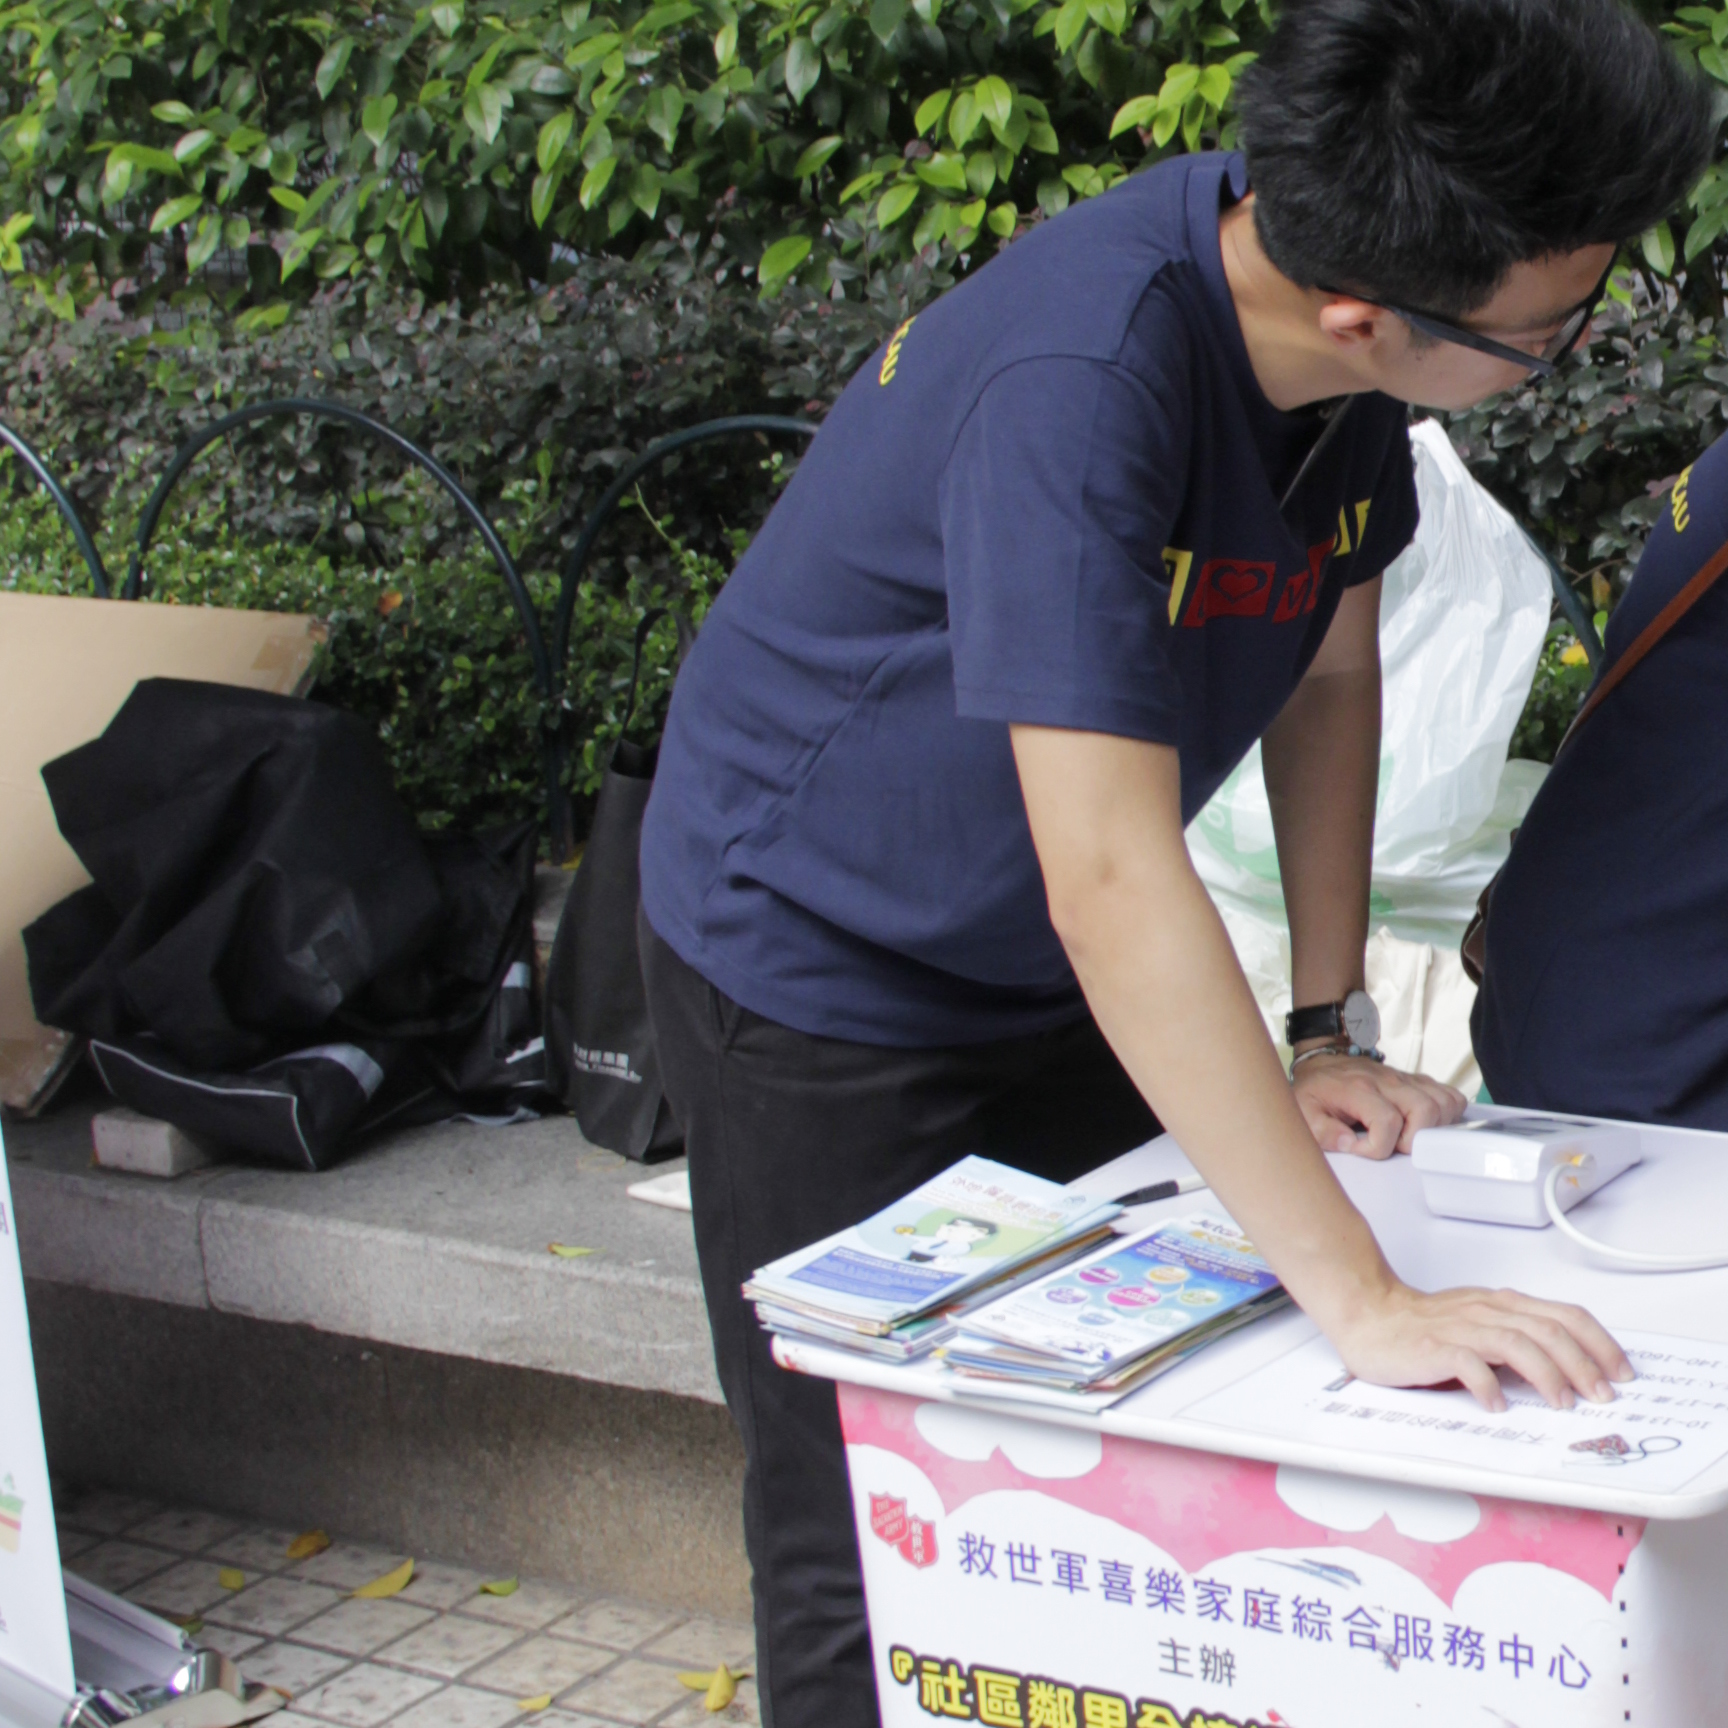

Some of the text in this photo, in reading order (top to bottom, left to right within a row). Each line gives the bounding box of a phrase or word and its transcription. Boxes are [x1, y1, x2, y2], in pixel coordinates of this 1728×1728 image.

[956, 1531, 1592, 1690] 救世軍喜樂家庭綜合服務中心
[1157, 1638, 1238, 1688] 主辦
